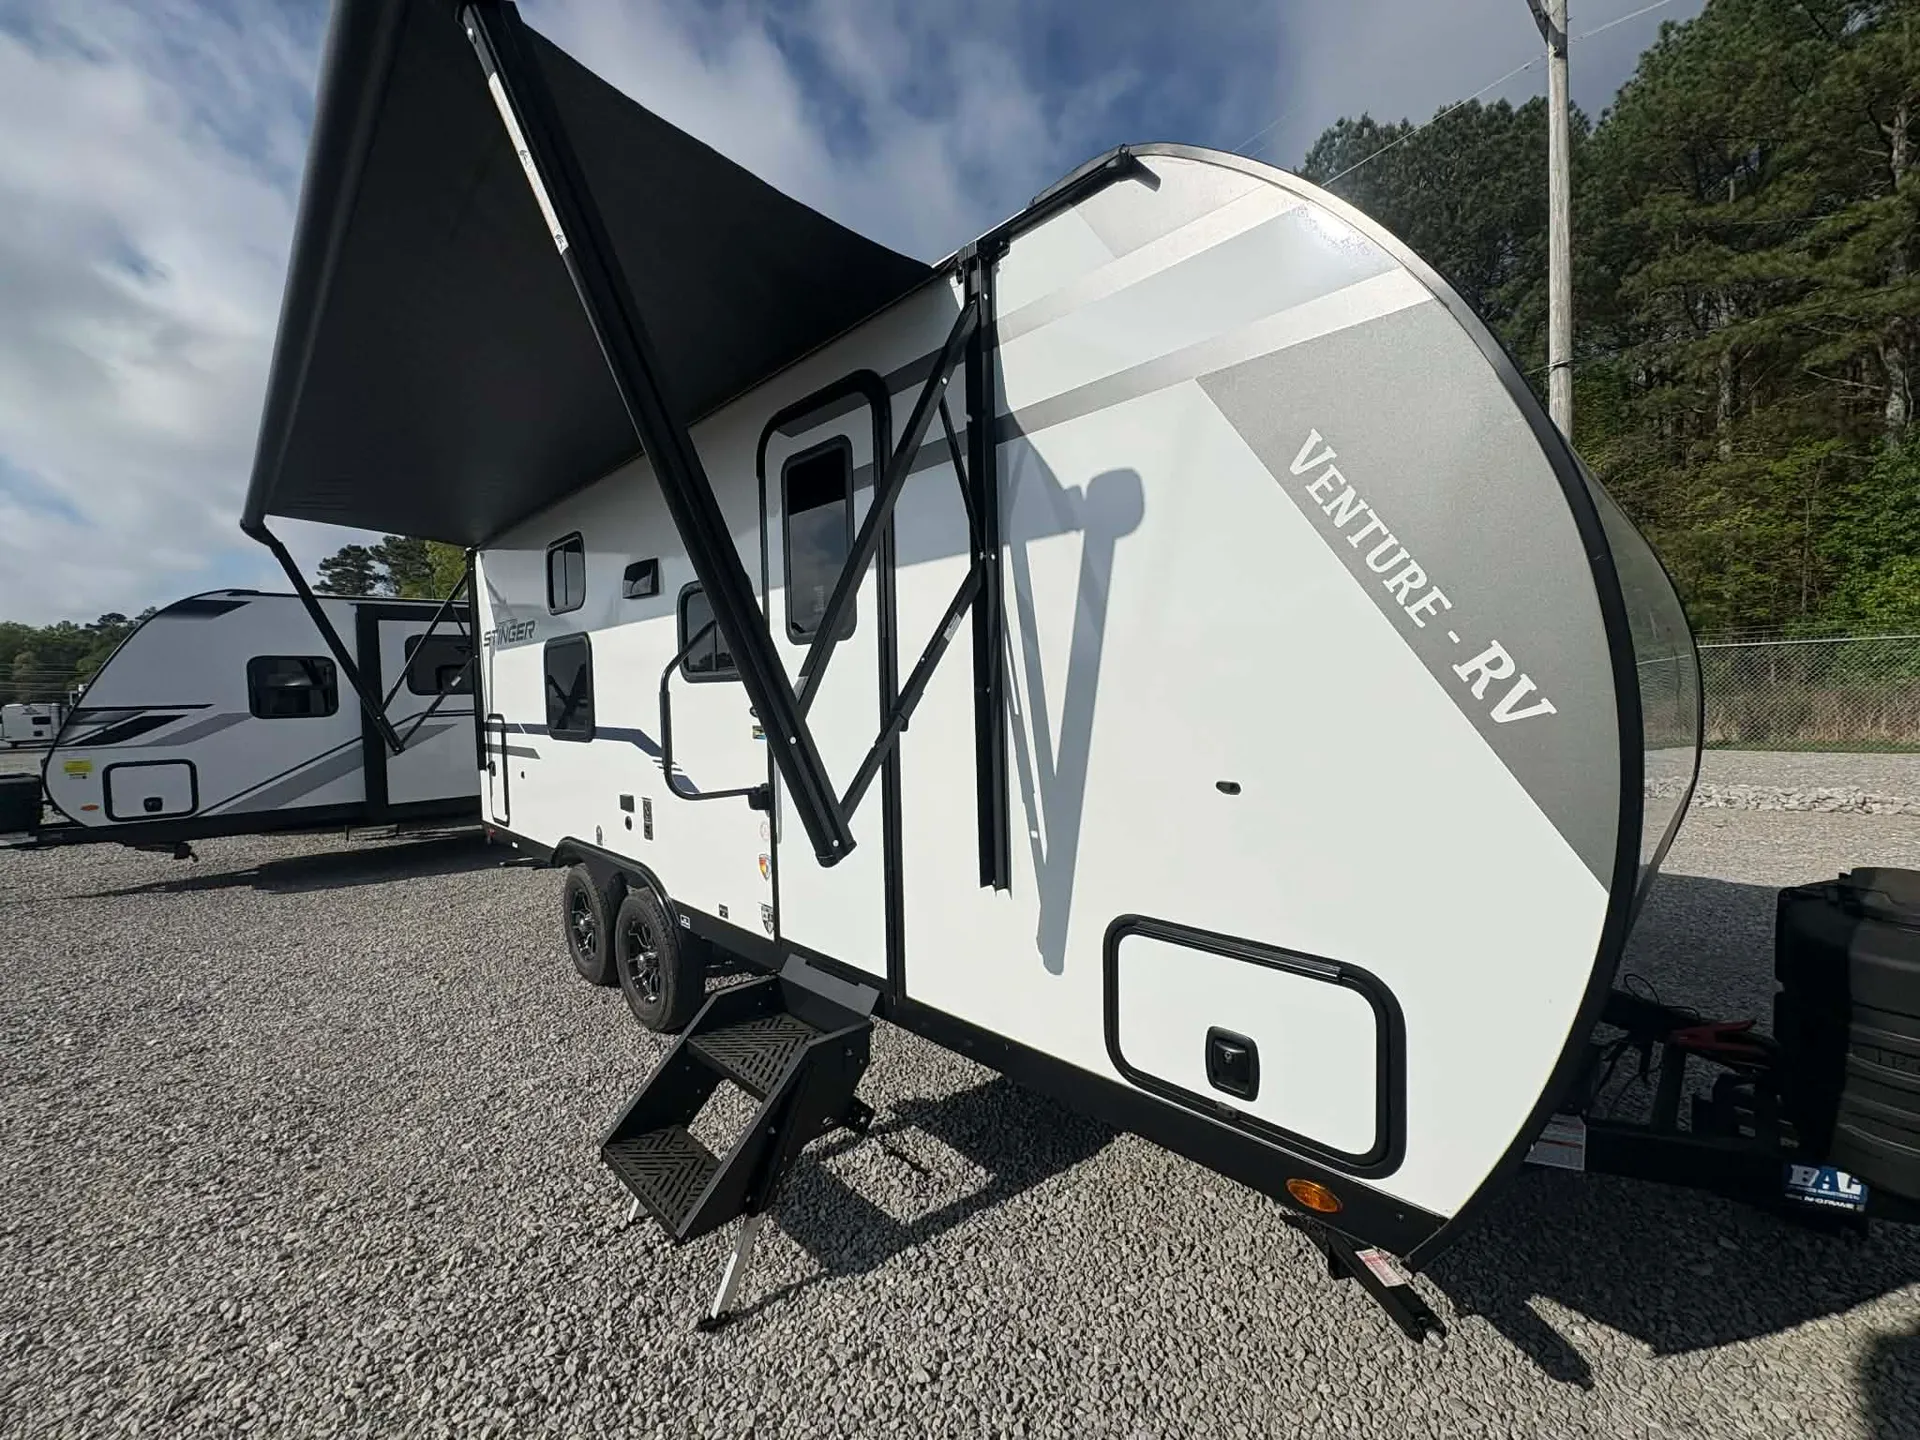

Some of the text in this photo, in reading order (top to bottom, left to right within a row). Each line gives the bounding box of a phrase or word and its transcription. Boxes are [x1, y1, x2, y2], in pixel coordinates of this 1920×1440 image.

[483, 620, 536, 647] STINGER
[1289, 428, 1453, 629] VENTURE
[1452, 639, 1558, 724] RV
